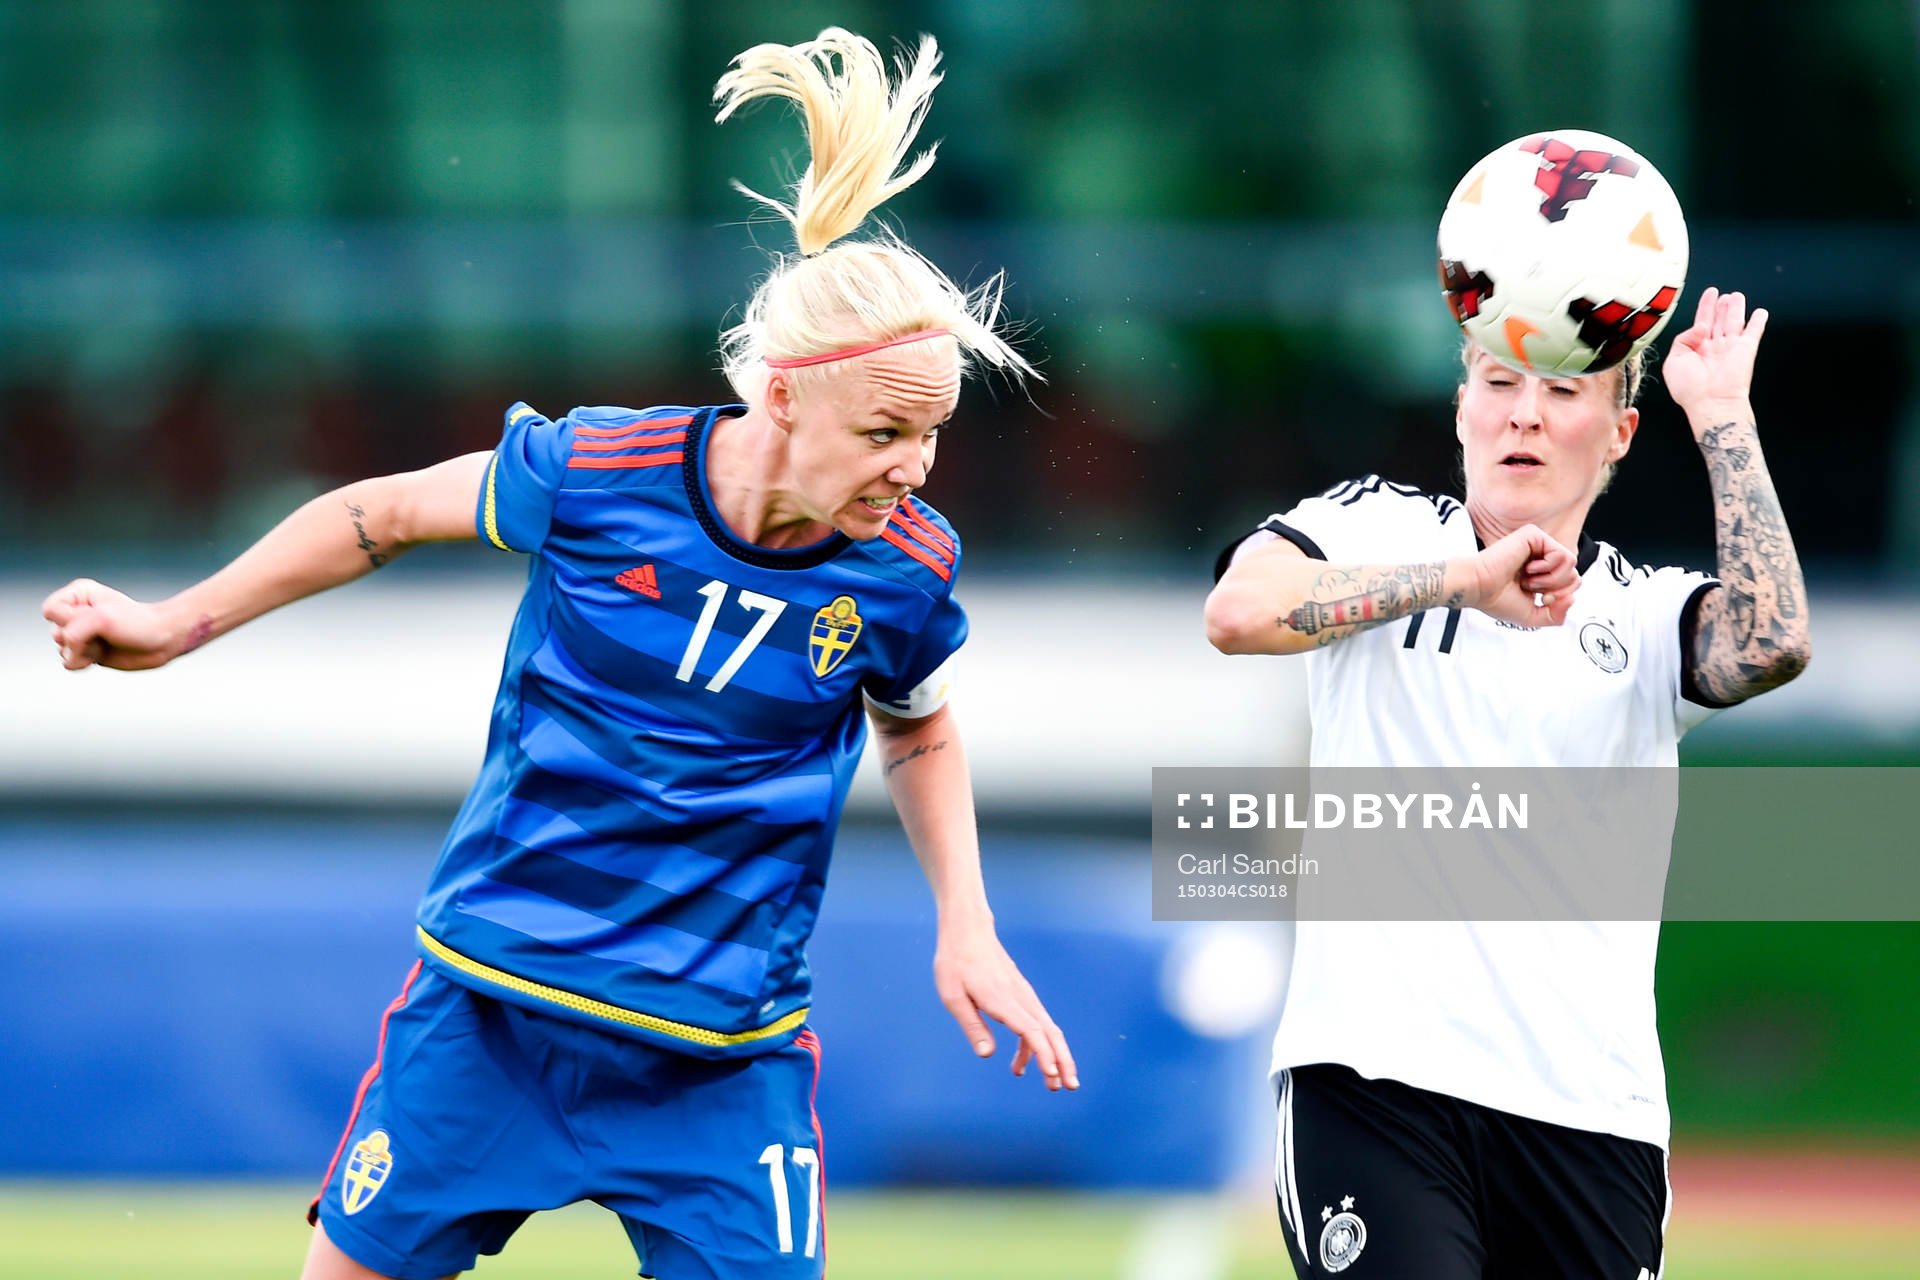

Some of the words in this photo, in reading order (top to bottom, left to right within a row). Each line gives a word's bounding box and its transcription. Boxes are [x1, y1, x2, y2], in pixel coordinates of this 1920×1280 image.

[615, 574, 662, 599] adidas
[675, 579, 788, 693] 17
[758, 1143, 820, 1258] 17
